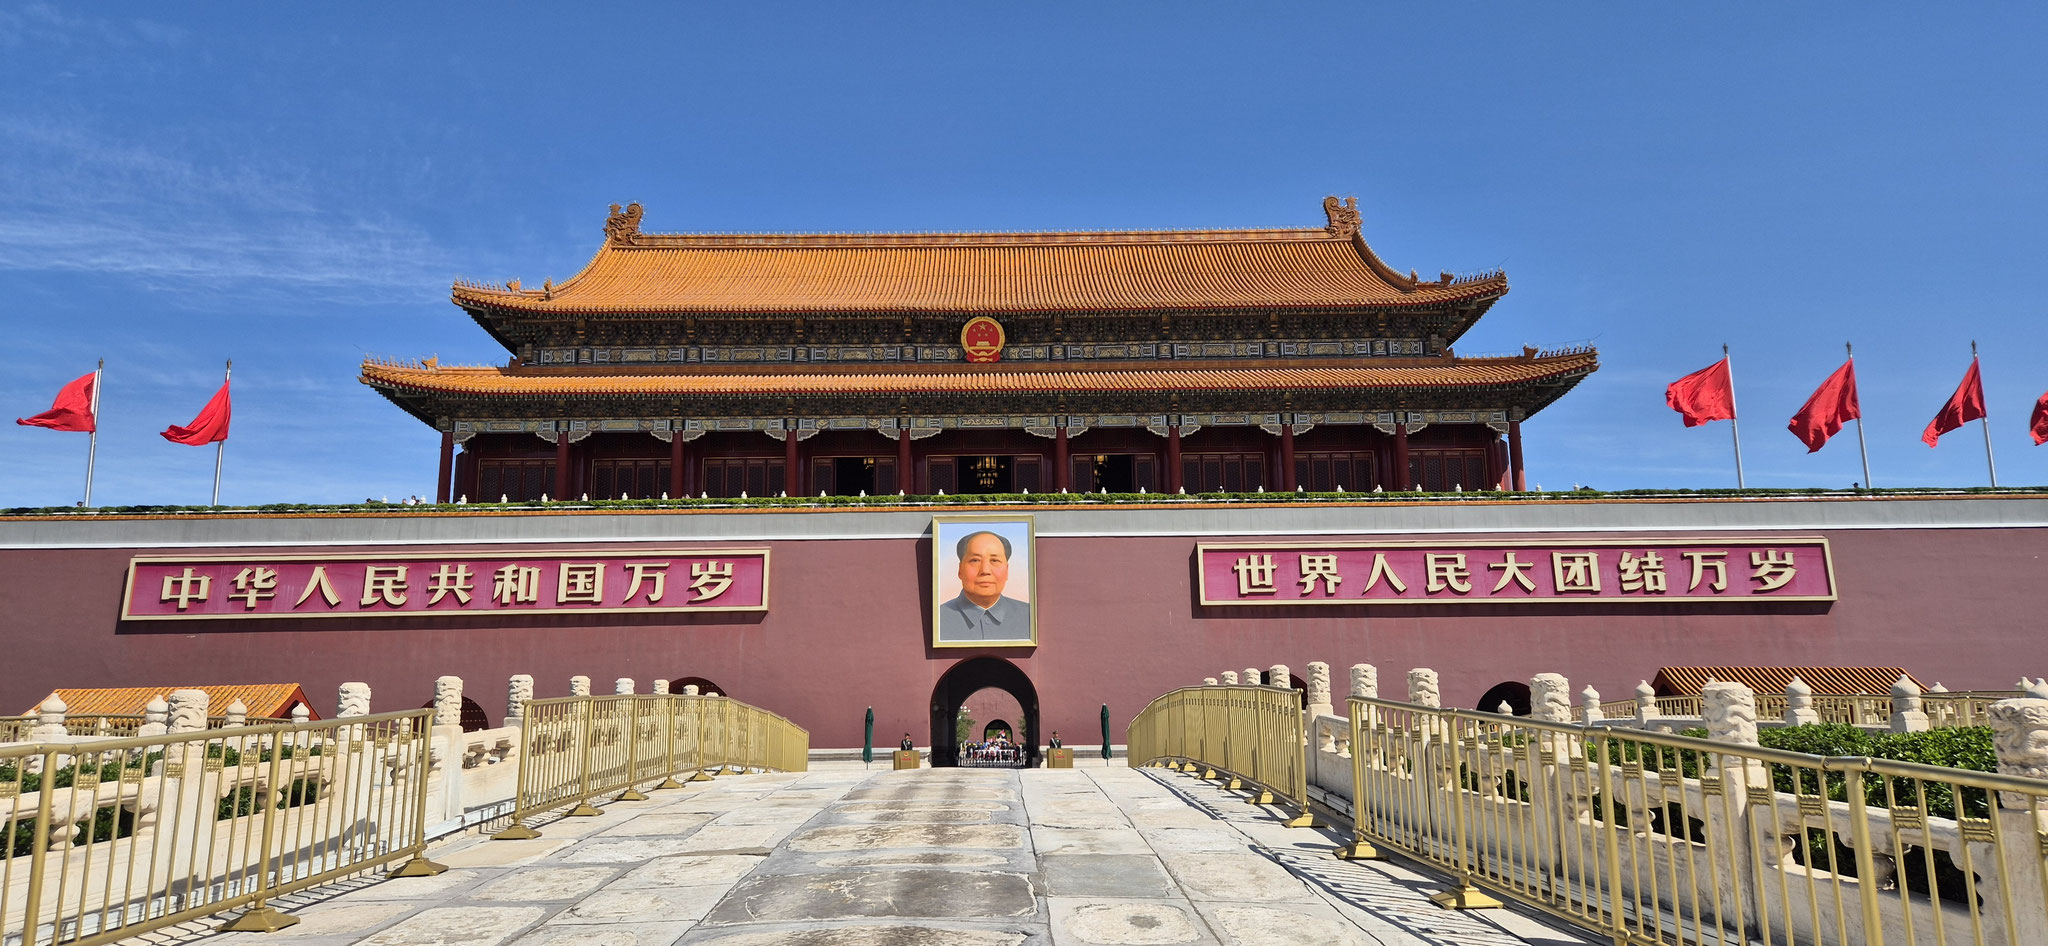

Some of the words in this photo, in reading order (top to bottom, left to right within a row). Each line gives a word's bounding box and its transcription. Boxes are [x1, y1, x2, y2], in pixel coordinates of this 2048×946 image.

[159, 561, 735, 609] 中华人民共和国万岁
[1233, 550, 1797, 595] 世界人民大团结万岁
